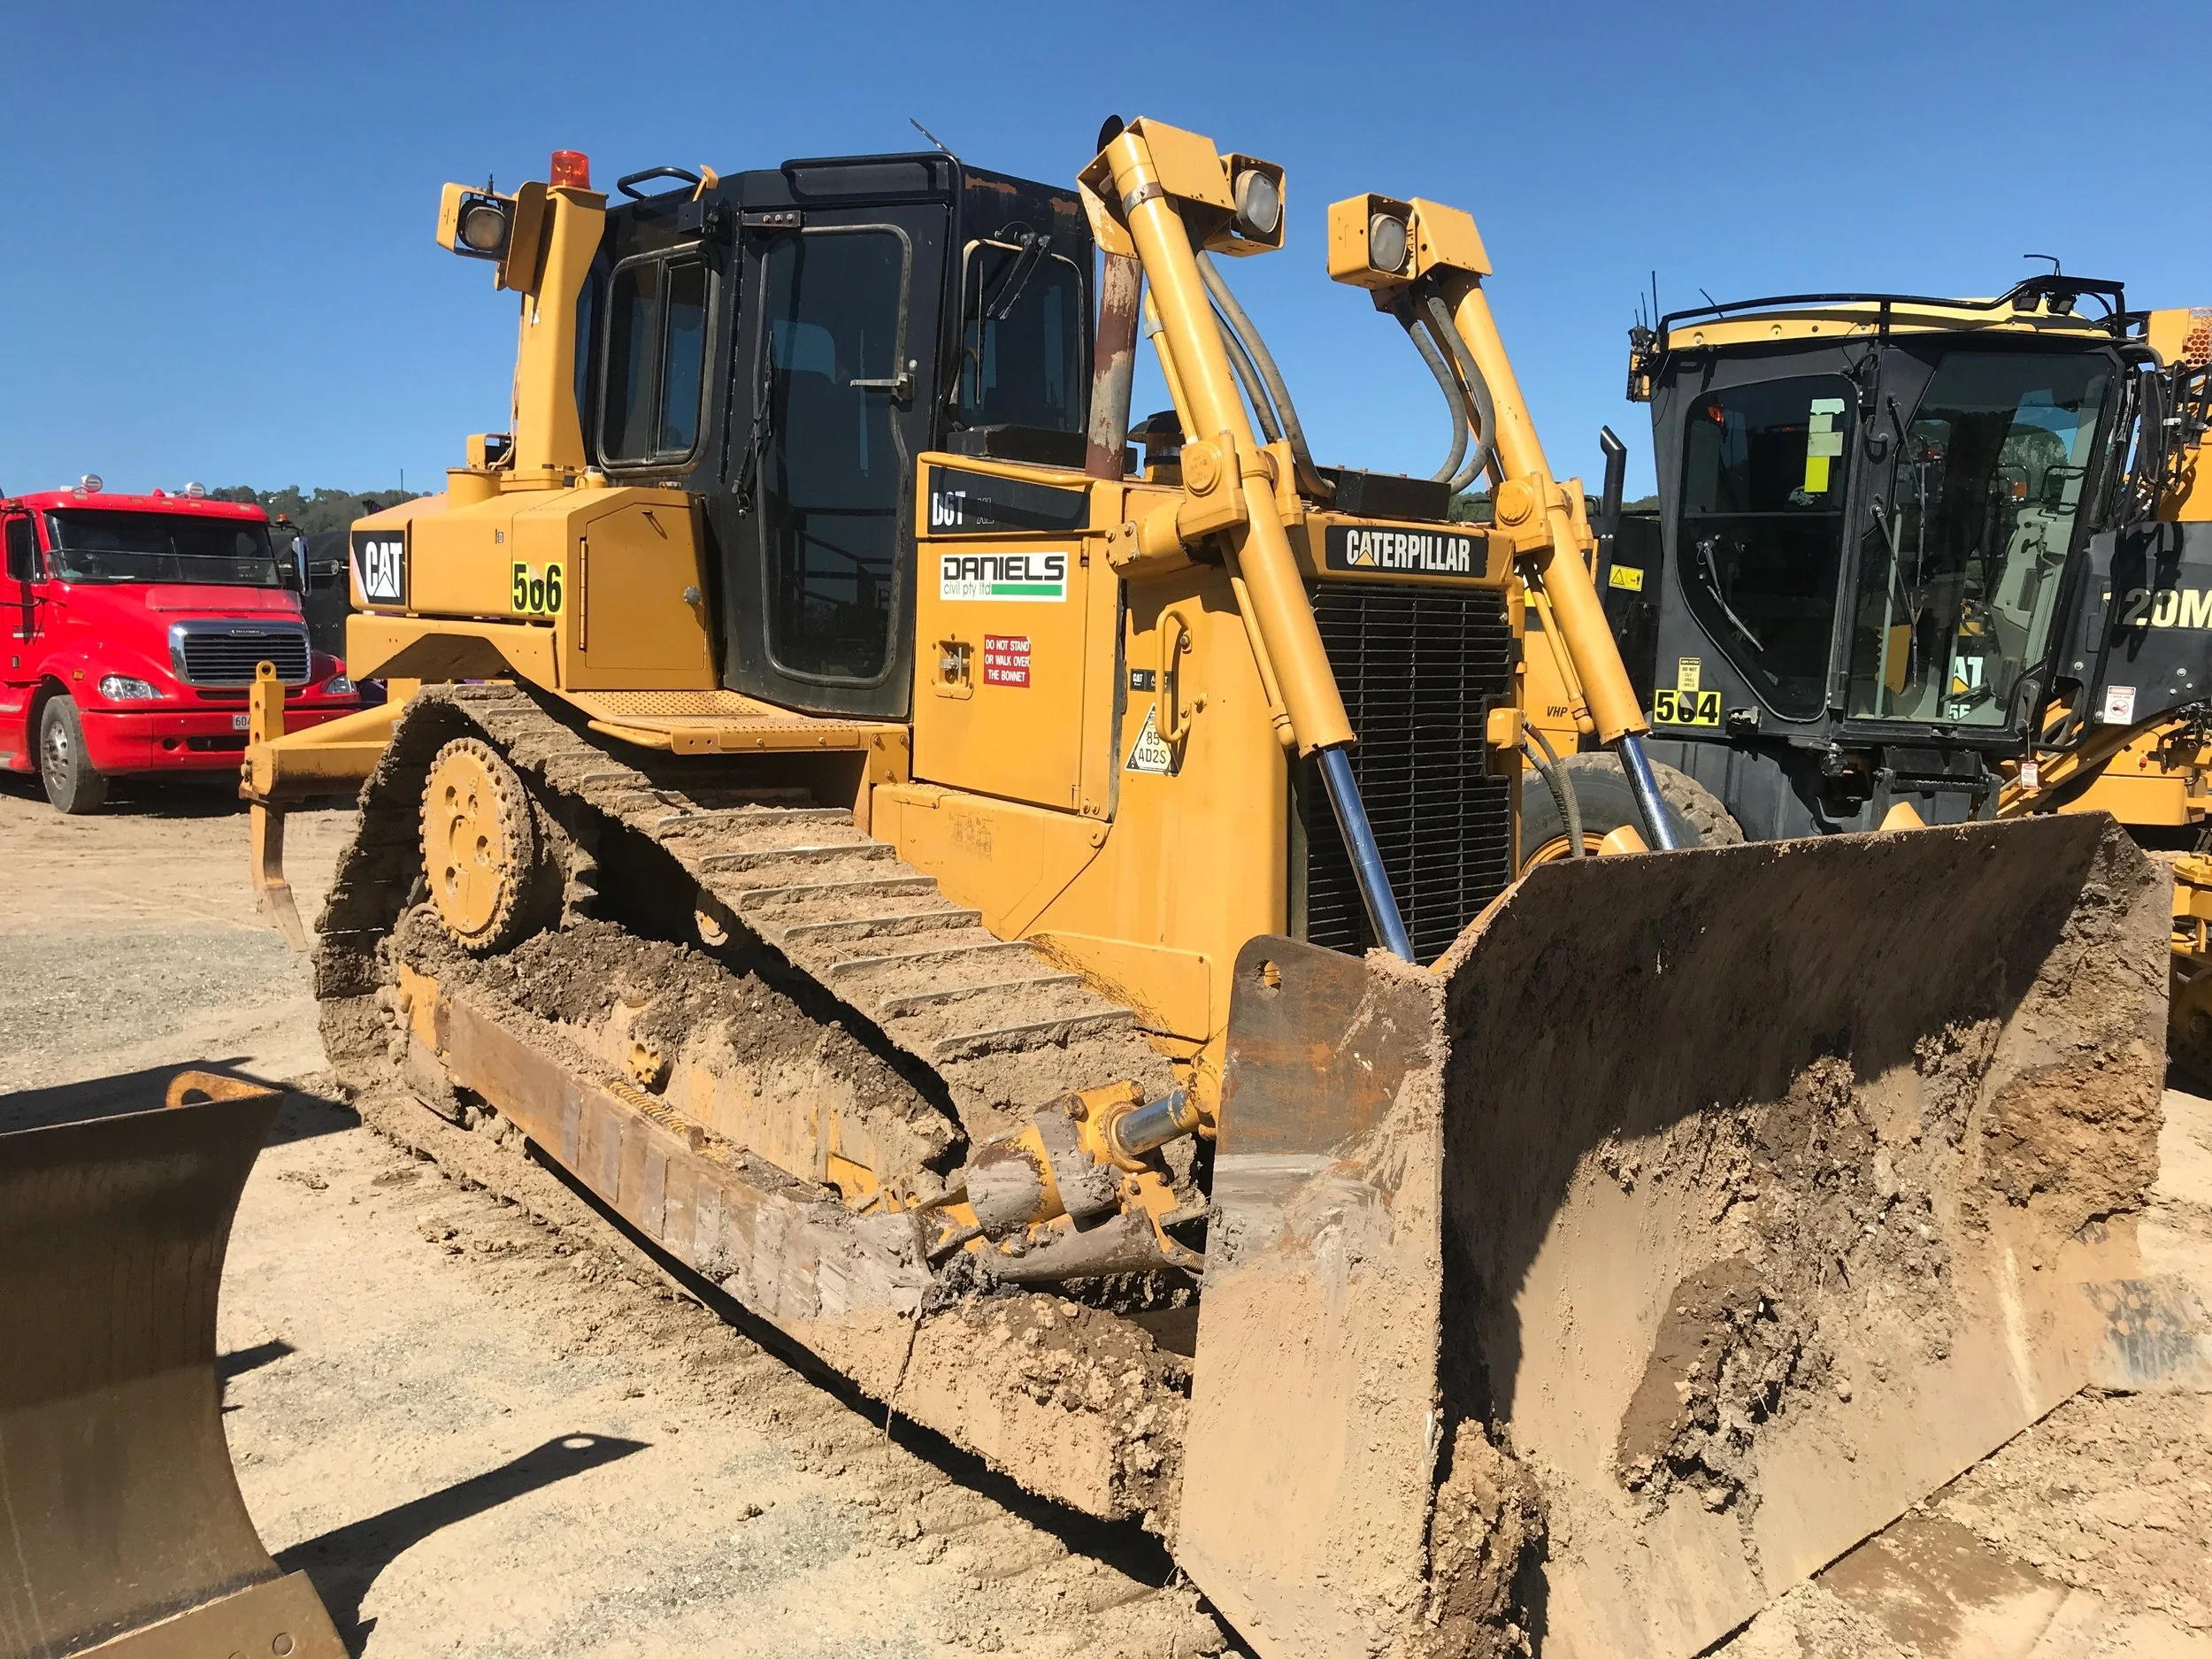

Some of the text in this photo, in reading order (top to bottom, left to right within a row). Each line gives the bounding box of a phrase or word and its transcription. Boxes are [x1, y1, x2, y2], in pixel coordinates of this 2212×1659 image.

[932, 490, 966, 526] D6T
[1346, 529, 1470, 572] CATERPILLAR
[365, 541, 403, 598] CAT
[943, 556, 1065, 581] DANIELS
[943, 581, 991, 598] civil pty ltd
[985, 639, 1030, 652] DO NOT STAND
[985, 654, 1030, 668] OR WALK OVER
[987, 669, 1026, 682] THE BONNET
[1133, 672, 1144, 683] CAT
[1952, 657, 1984, 688] AT
[1547, 705, 1568, 718] VHP
[1146, 731, 1160, 746] 85
[1138, 748, 1167, 764] AD2S
